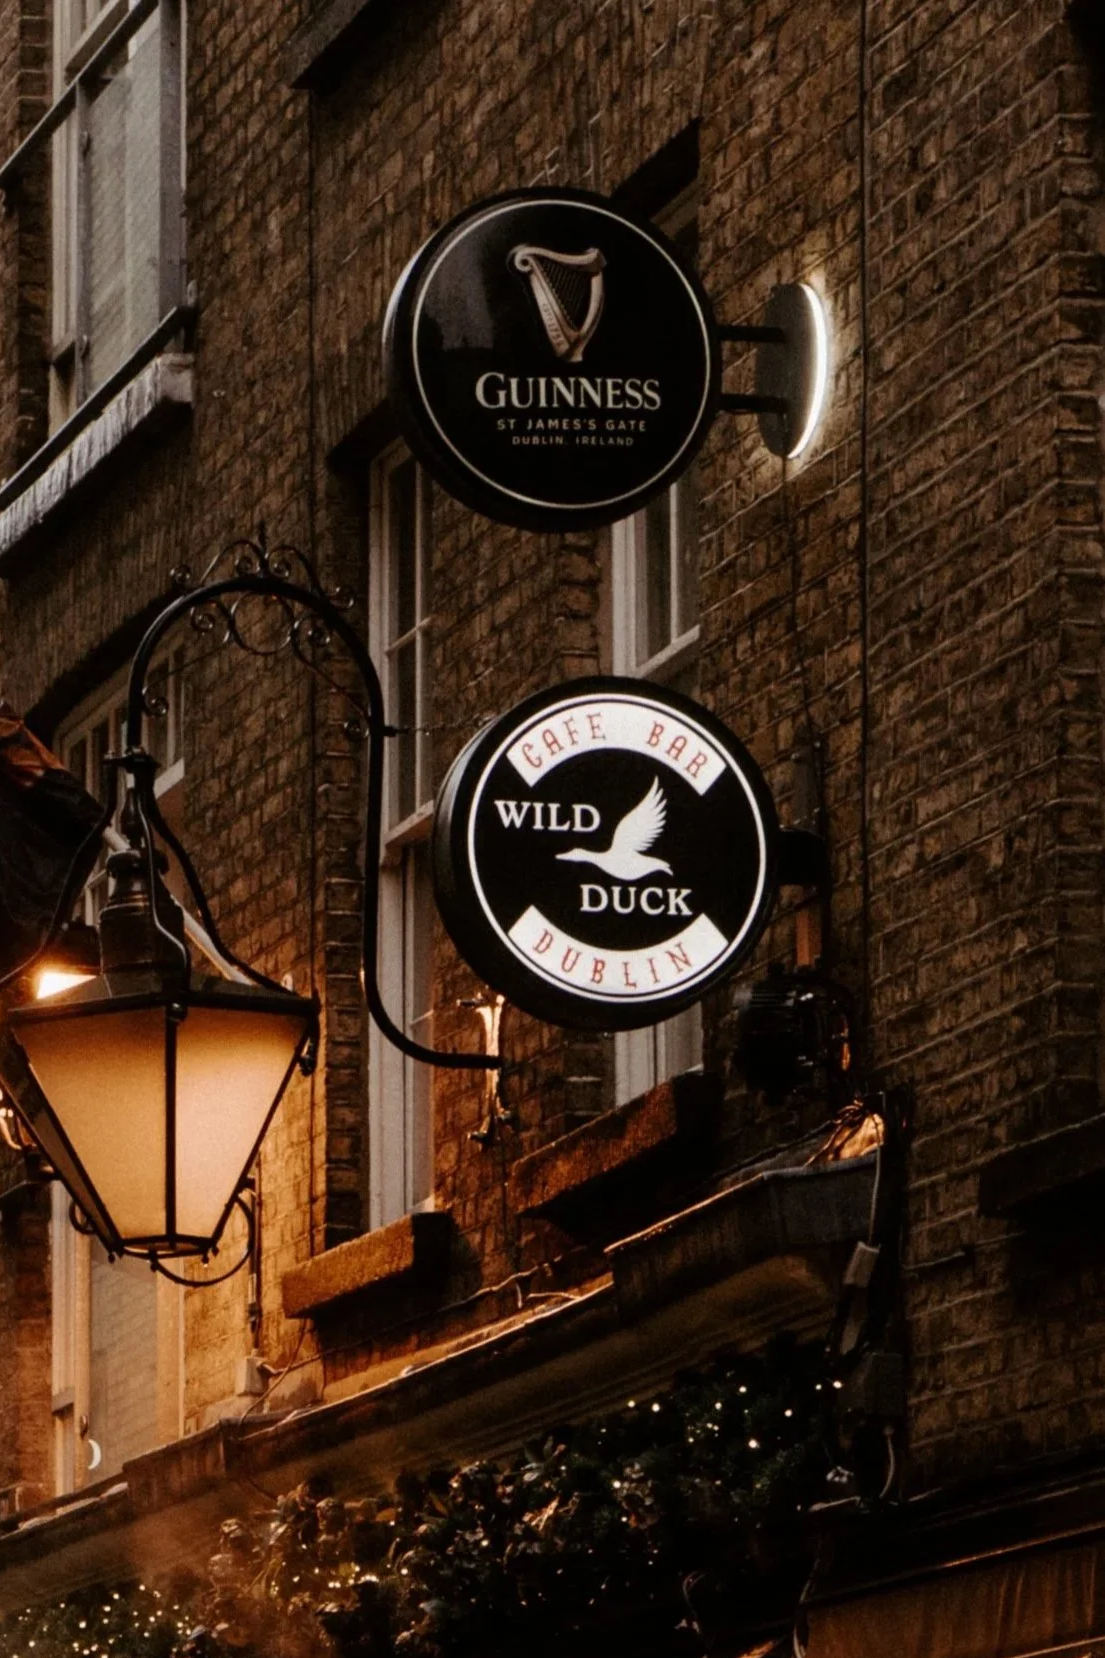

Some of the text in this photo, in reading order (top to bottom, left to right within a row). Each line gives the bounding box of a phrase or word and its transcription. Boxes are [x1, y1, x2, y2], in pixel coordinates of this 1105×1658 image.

[474, 371, 663, 411] GUINNESS
[496, 417, 647, 432] ST JAMES'S GATE
[575, 435, 634, 447] IRELAND
[521, 712, 708, 779] CAFE BAR
[493, 799, 602, 834] WILD
[579, 883, 694, 917] DUCK
[532, 929, 693, 988] DUBLIN
